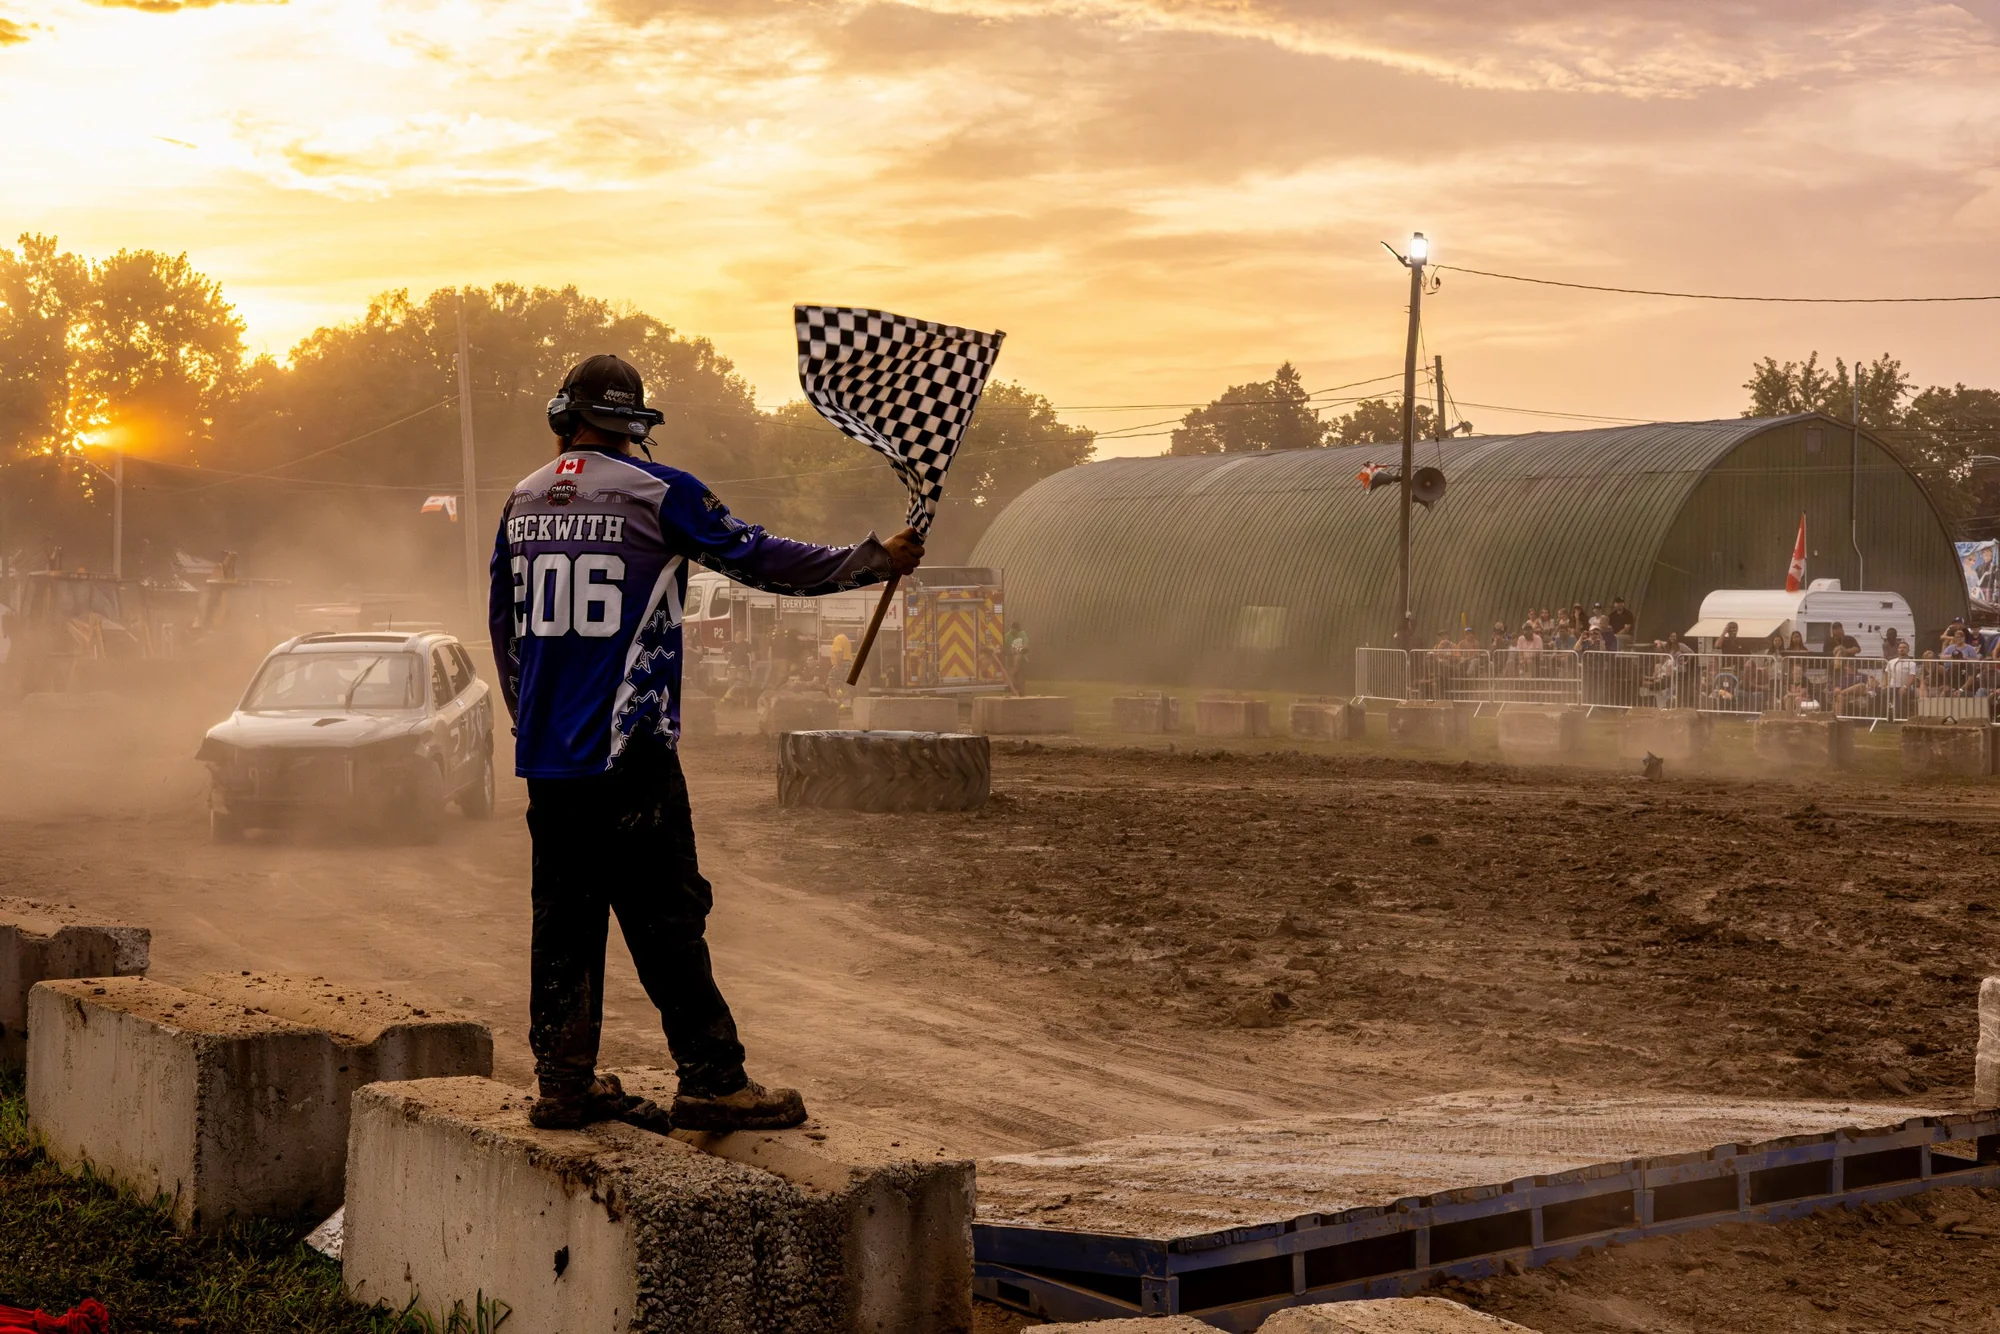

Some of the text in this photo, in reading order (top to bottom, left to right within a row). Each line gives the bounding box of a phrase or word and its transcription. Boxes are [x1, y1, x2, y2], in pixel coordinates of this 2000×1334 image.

[606, 389, 636, 399] IMPACT
[551, 485, 576, 493] SMASH
[507, 514, 625, 545] BECKWITH
[782, 599, 802, 608] EVERY
[713, 627, 725, 639] P2
